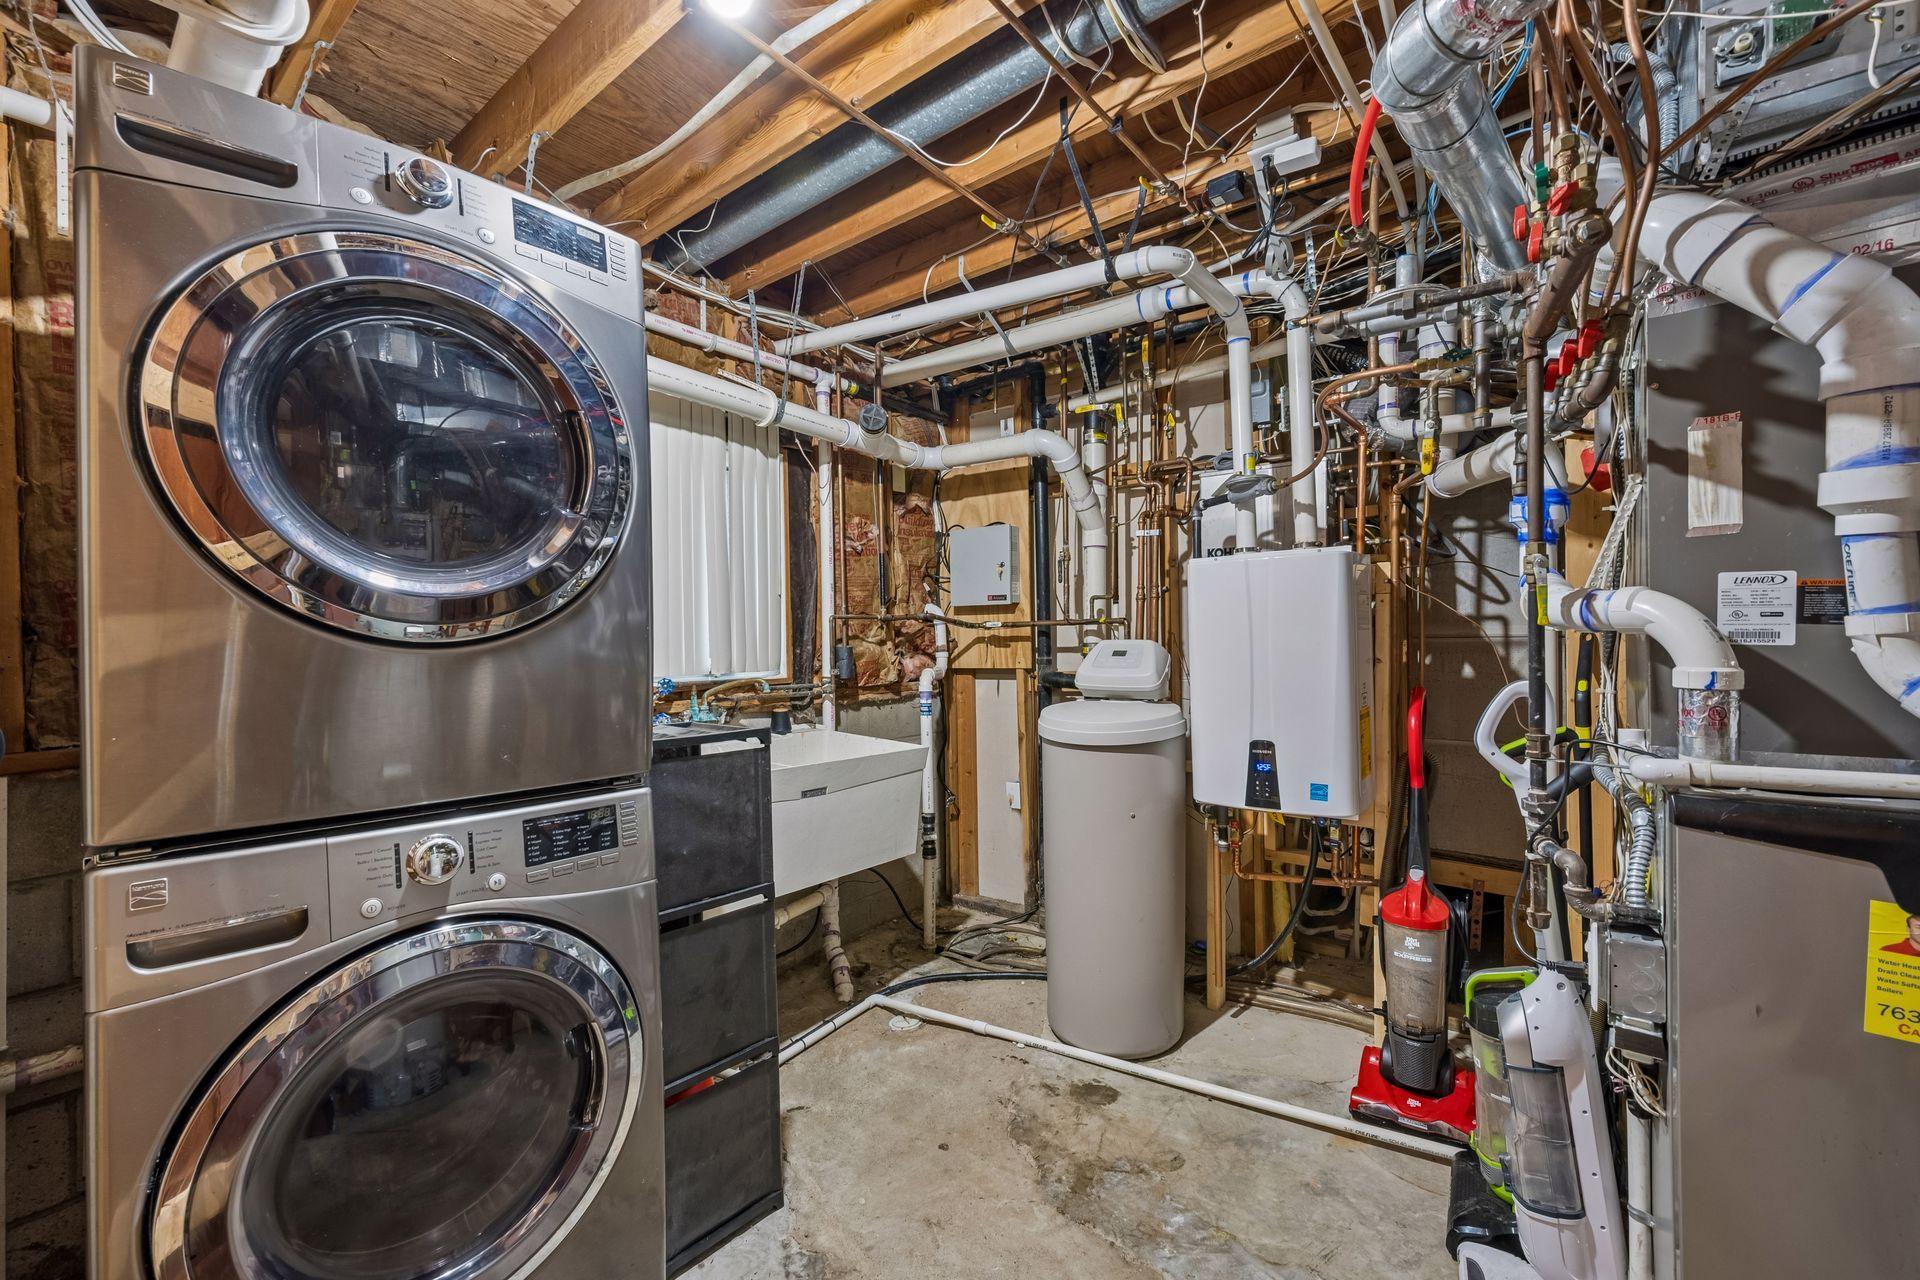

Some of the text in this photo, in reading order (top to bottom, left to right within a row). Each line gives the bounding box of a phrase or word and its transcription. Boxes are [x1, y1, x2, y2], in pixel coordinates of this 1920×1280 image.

[1733, 574, 1777, 586] LENNOX
[1877, 957, 1901, 968] Water
[1876, 966, 1899, 976] Drain
[1875, 976, 1900, 987] Water
[1875, 985, 1904, 996] Boilers
[1877, 1002, 1920, 1024] 763
